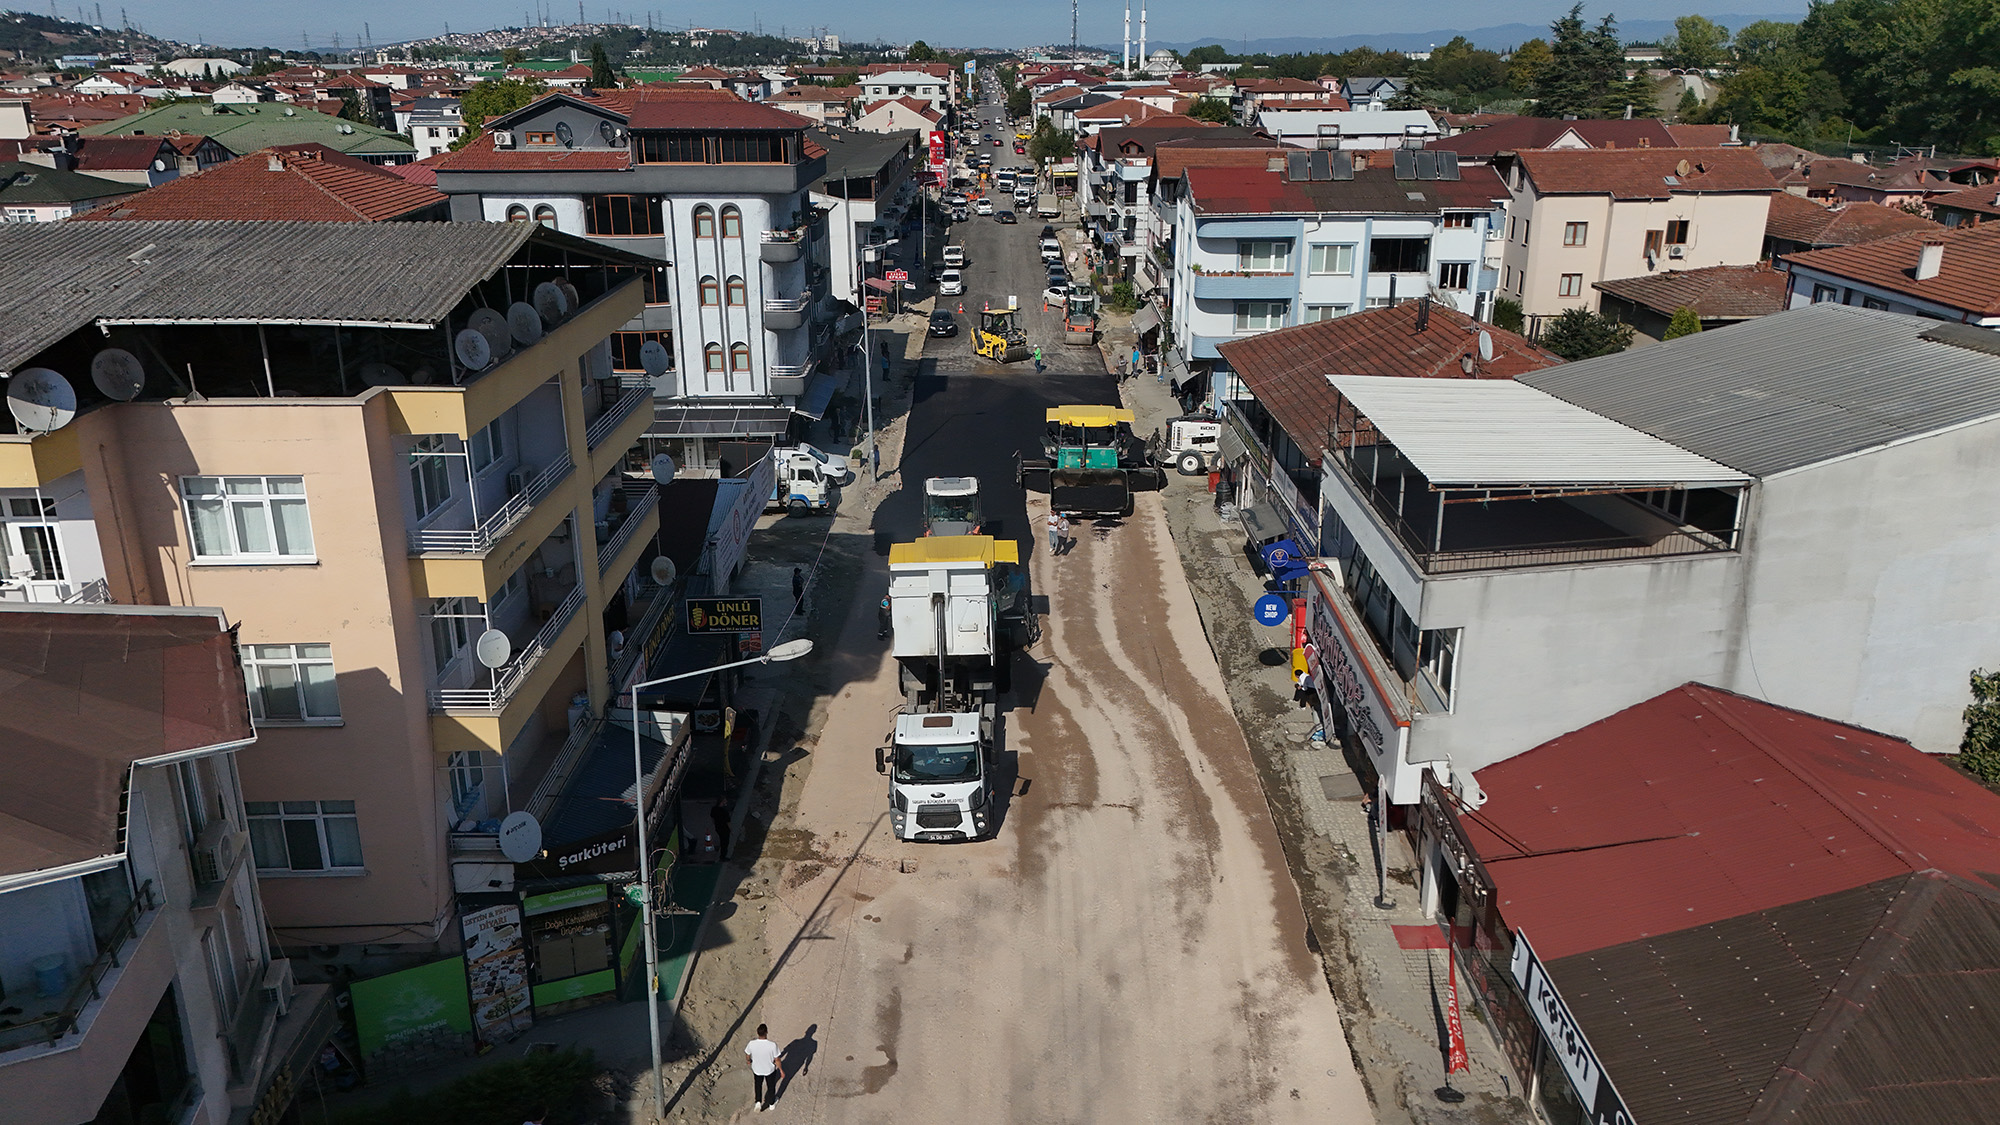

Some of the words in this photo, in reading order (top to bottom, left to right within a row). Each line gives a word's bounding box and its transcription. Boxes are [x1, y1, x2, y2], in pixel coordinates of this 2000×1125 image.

[716, 601, 751, 612] ÜNLÜ
[708, 612, 760, 627] DÖNER
[1264, 611, 1279, 619] SHOP
[558, 835, 627, 871] Şarküteri
[479, 916, 508, 932] DİYARI
[545, 917, 565, 930] Doğal
[560, 924, 585, 937] Ürünler
